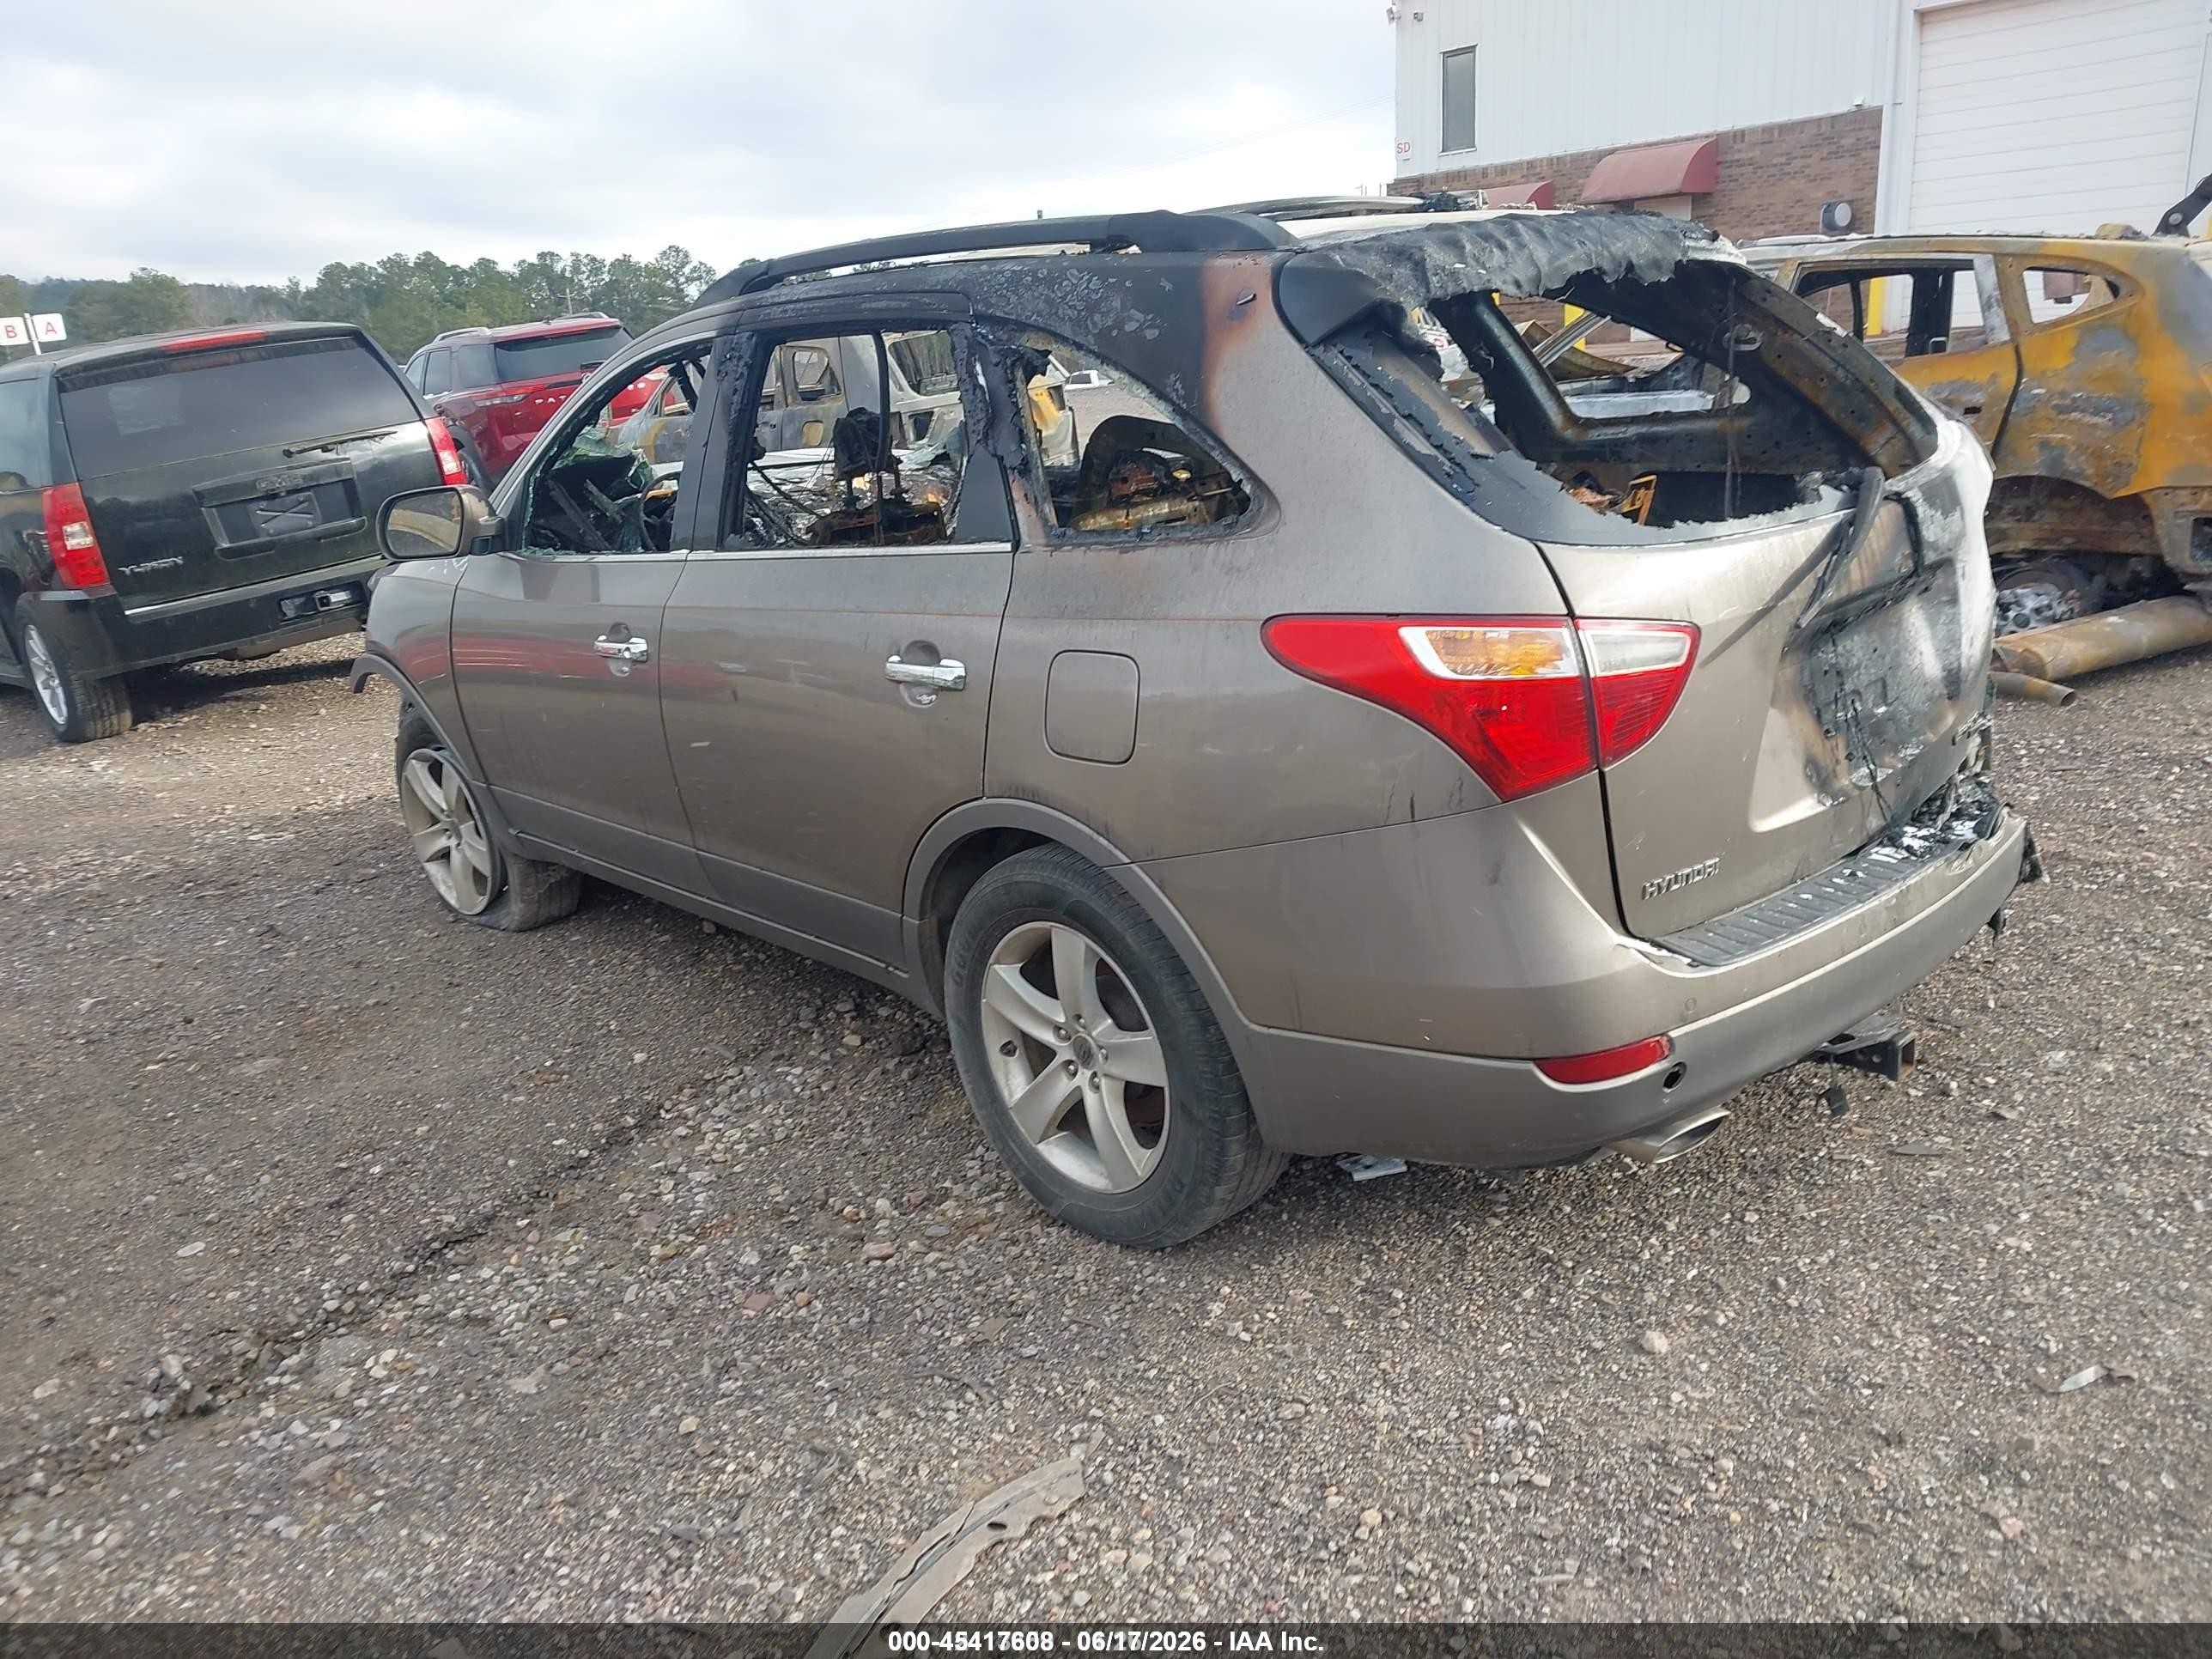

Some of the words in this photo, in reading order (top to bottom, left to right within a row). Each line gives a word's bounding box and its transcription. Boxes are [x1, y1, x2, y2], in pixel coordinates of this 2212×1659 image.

[1396, 142, 1411, 154] SD
[4, 325, 17, 338] B
[45, 321, 58, 335] A
